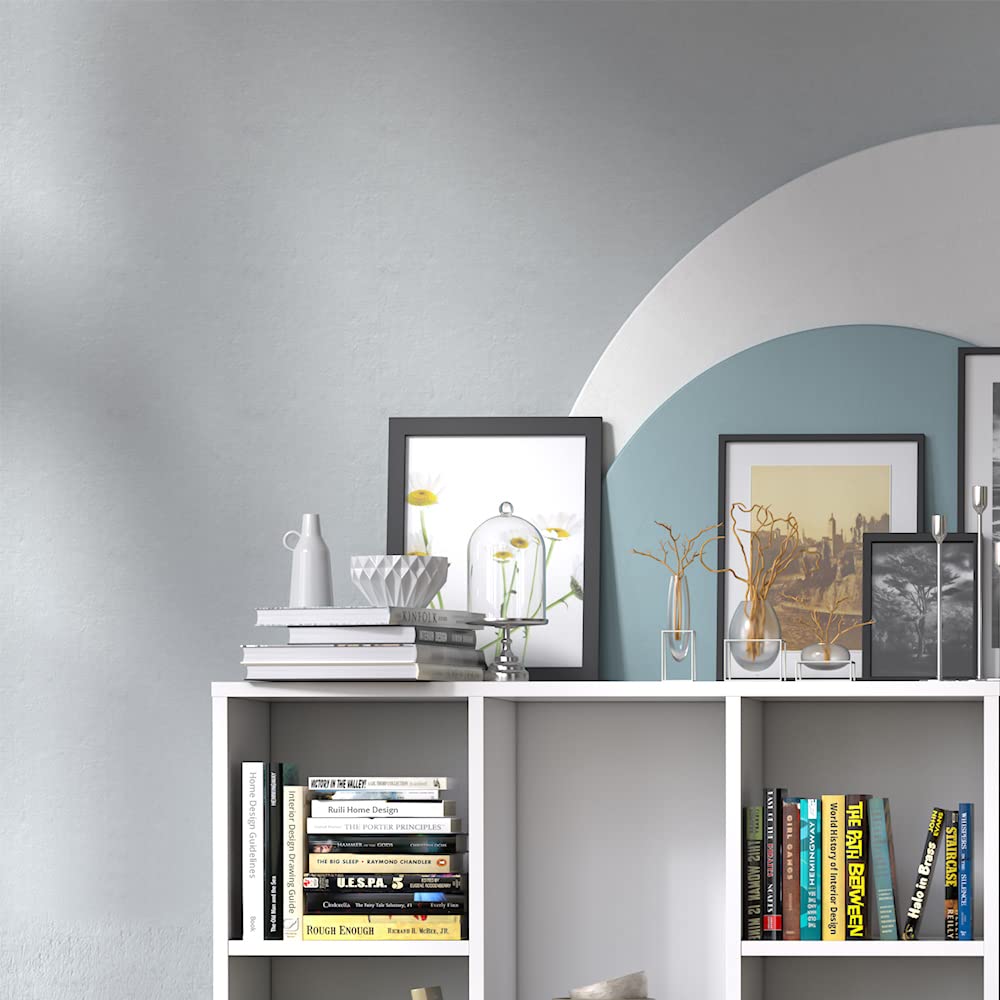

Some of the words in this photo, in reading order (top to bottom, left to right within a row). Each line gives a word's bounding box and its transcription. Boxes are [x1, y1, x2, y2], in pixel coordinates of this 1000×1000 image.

[311, 780, 330, 788] VICTORY
[330, 780, 336, 788] IN
[337, 780, 346, 788] THE
[347, 780, 366, 788] VALLEY!
[247, 801, 256, 830] Design
[288, 791, 296, 821] Interior
[328, 806, 345, 814] Ruili
[347, 806, 370, 814] Home
[372, 806, 398, 815] Design
[830, 803, 838, 828] World
[846, 802, 863, 827] THE
[928, 810, 938, 833] JOHN
[933, 812, 944, 836] EVANS
[287, 825, 296, 852] Design
[828, 830, 838, 861] History
[846, 830, 863, 859] PATH
[249, 833, 257, 878] Guidelines
[830, 863, 838, 871] of
[918, 842, 936, 875] Brass
[946, 826, 957, 887] STAIRCASE
[287, 854, 296, 887] Drawing
[916, 877, 928, 890] in
[288, 889, 296, 914] Guide
[830, 873, 838, 905] Interior
[848, 863, 865, 937] BETWEEN
[908, 889, 924, 920] Halo
[307, 926, 336, 935] ROUGH
[339, 926, 374, 935] ENOUGH
[828, 907, 838, 935] Design
